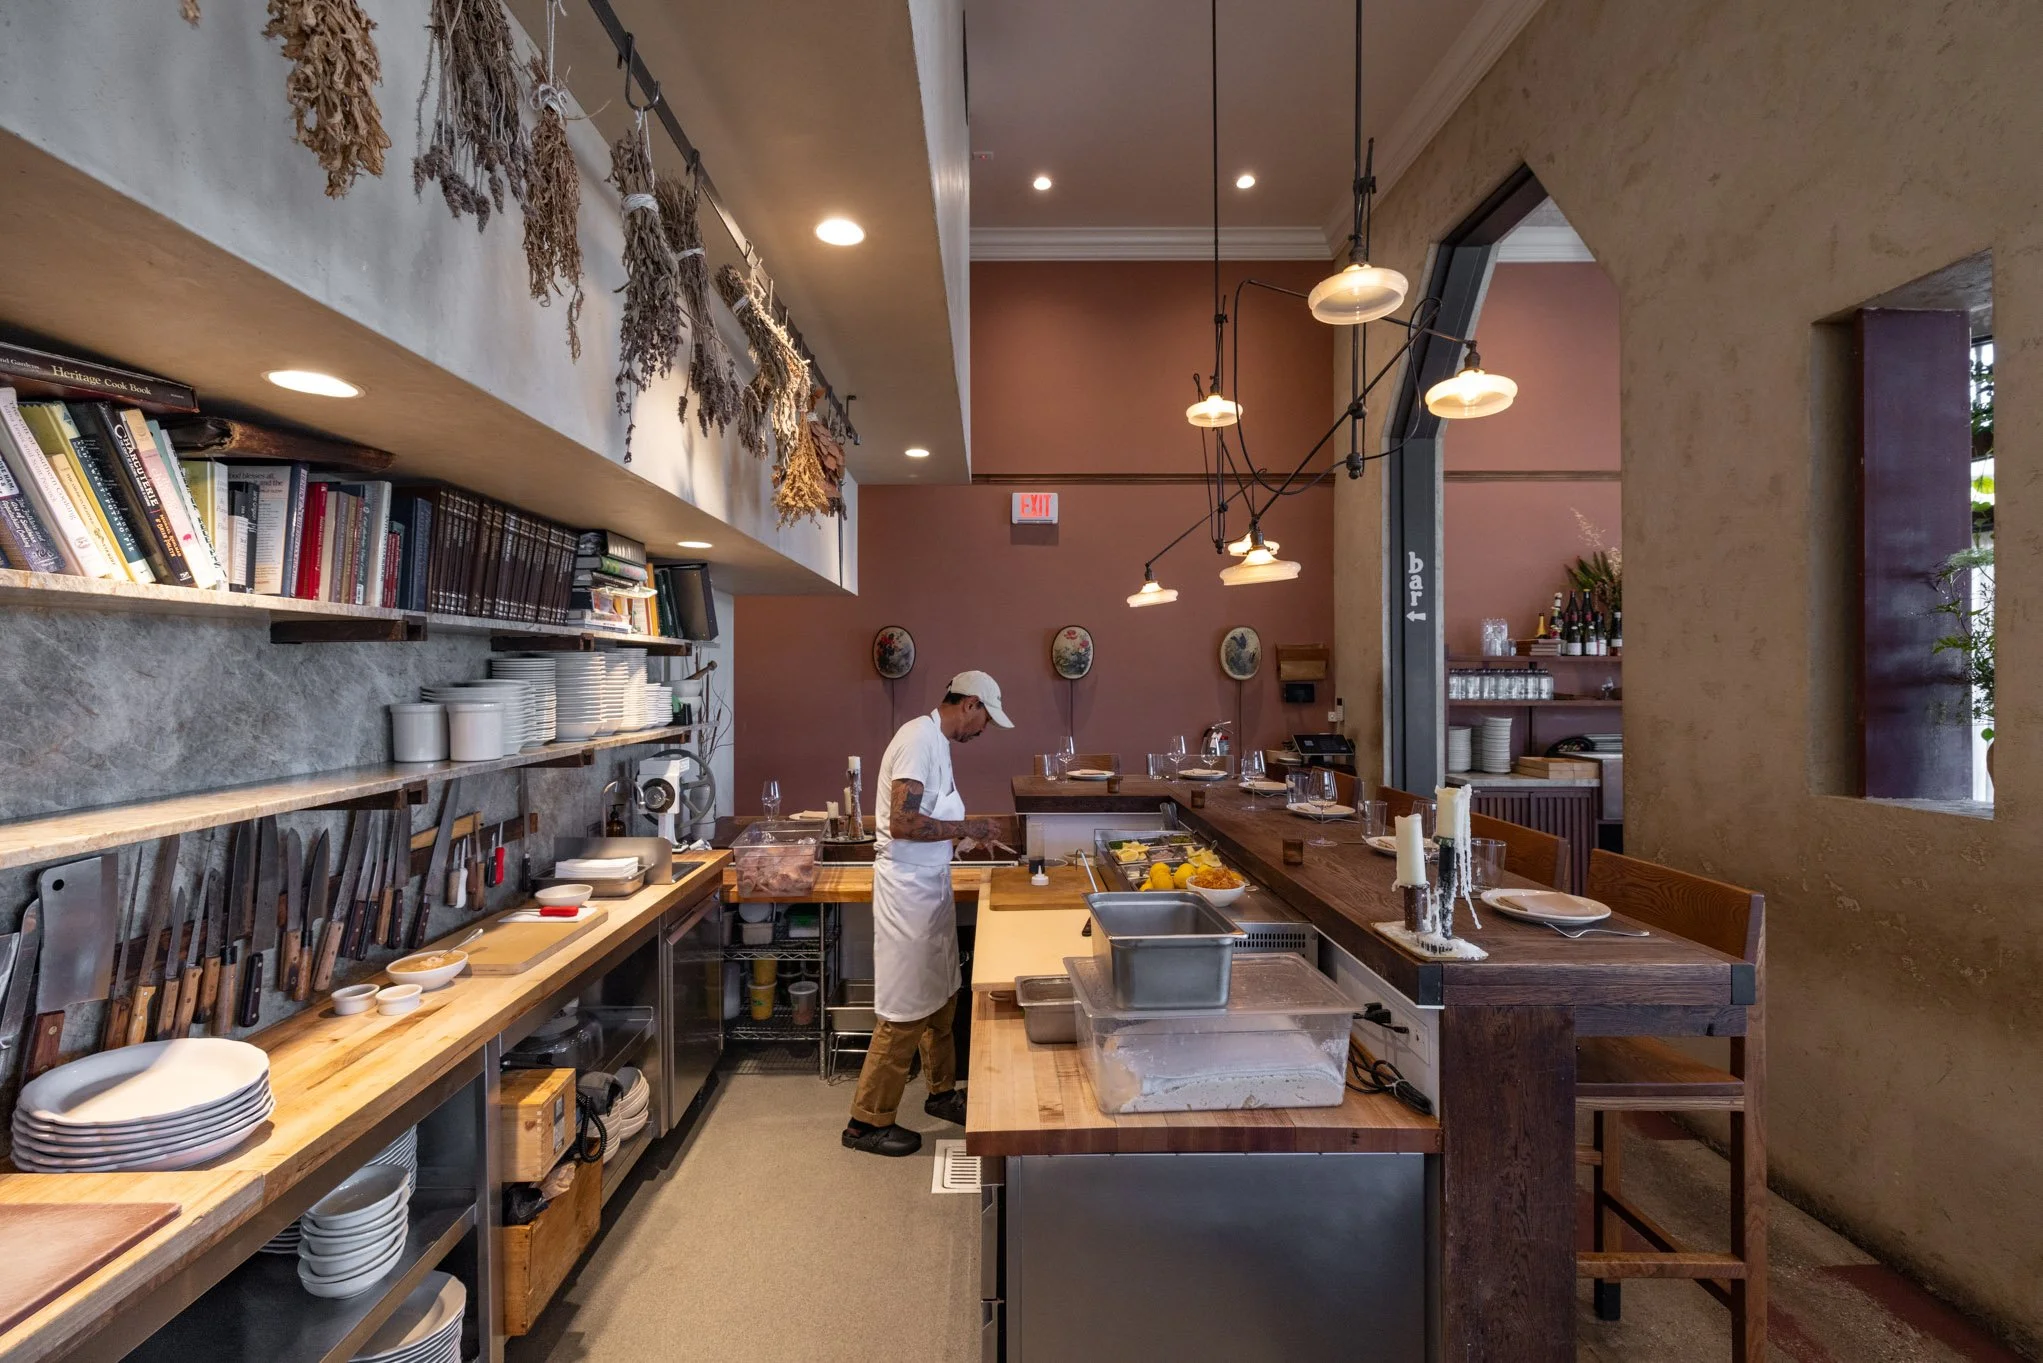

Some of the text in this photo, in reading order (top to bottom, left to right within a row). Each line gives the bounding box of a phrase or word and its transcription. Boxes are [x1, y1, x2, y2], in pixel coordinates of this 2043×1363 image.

[51, 365, 152, 396] Heritage Cook Book
[8, 399, 18, 413] The
[34, 447, 58, 486] Southern
[112, 421, 160, 509] CHARCUTERIE
[1021, 495, 1051, 517] EXIT
[15, 527, 32, 549] Cooking
[34, 528, 46, 543] and
[122, 536, 135, 553] PIE
[1408, 551, 1424, 606] bar
